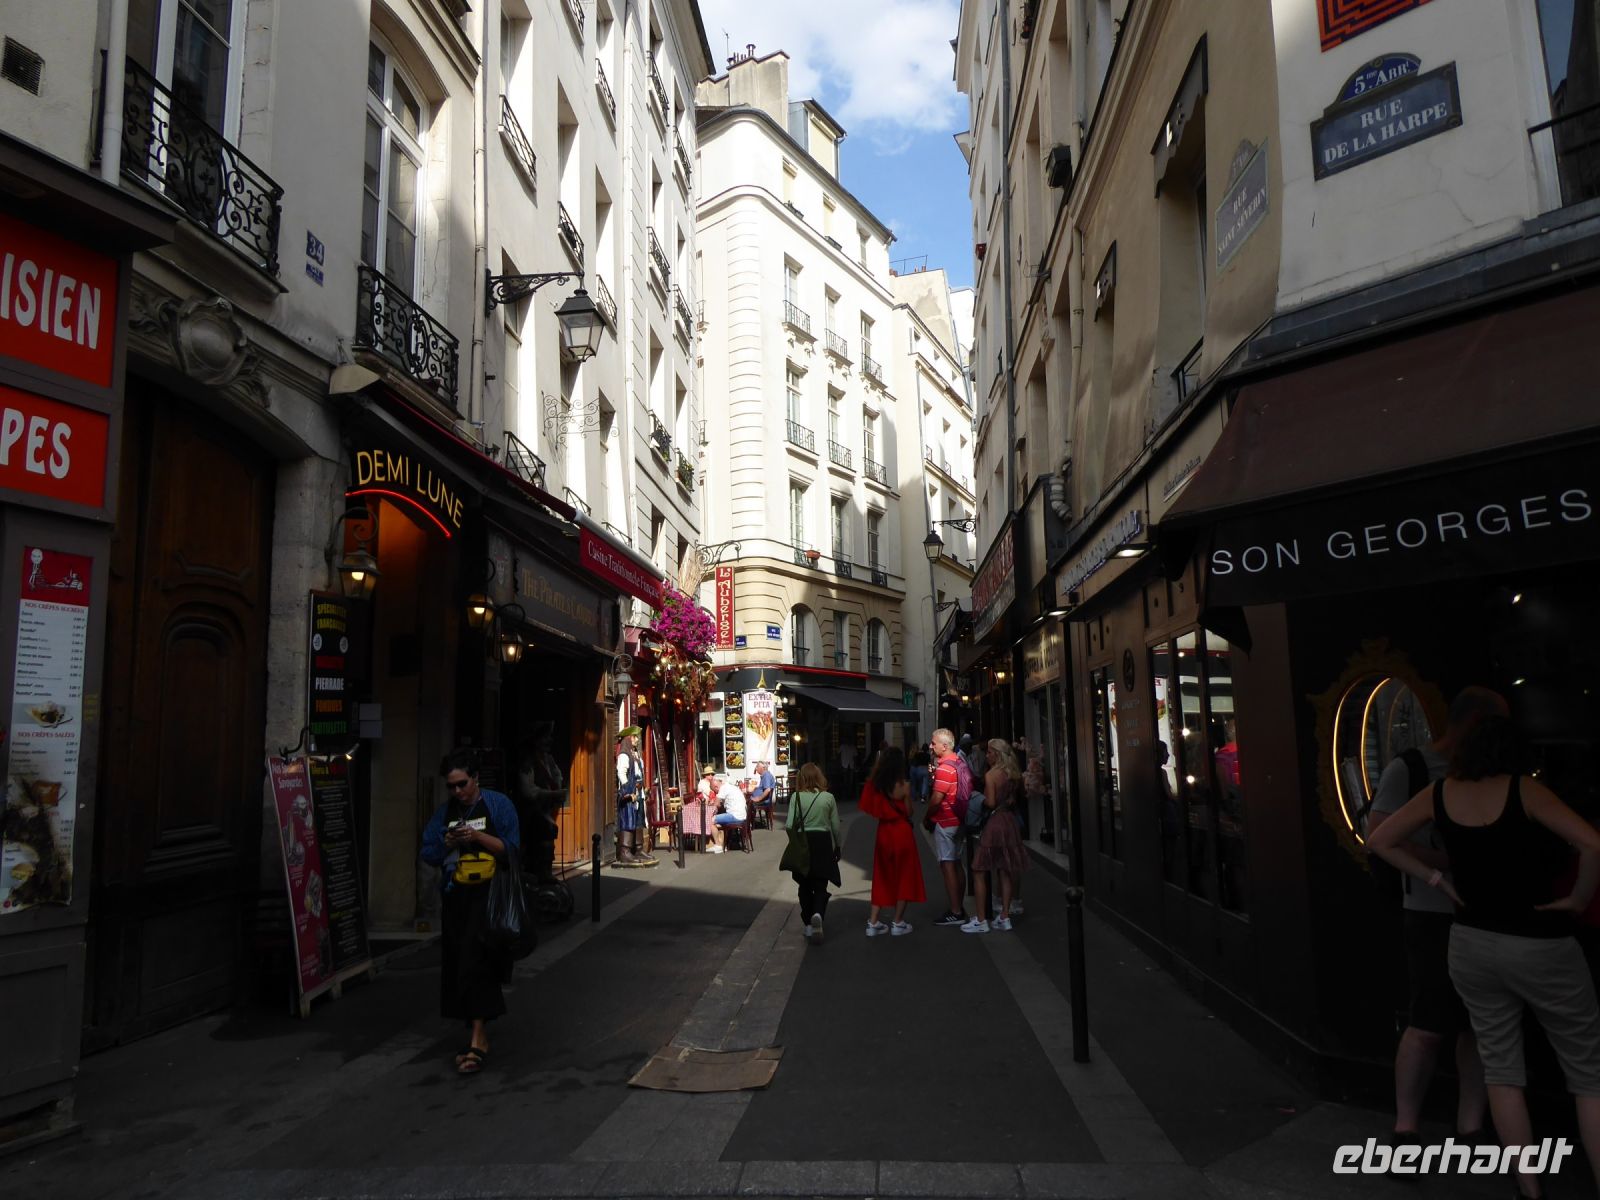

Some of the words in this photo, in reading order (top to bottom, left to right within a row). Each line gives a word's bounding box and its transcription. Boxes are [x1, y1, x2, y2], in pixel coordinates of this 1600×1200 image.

[1323, 141, 1349, 164] DE
[1352, 131, 1377, 152] LA
[1381, 102, 1447, 141] HARPE
[1360, 99, 1403, 128] RUE
[1233, 186, 1247, 215] RUE
[309, 236, 323, 263] 34
[0, 252, 101, 350] ISIEN
[0, 407, 72, 480] PES
[356, 449, 410, 486] DEMI
[416, 463, 464, 529] LUNE
[1211, 538, 1301, 576] SON
[1326, 487, 1593, 560] GEORGES
[315, 677, 345, 691] PIERRADE
[748, 693, 772, 701] EXTRA
